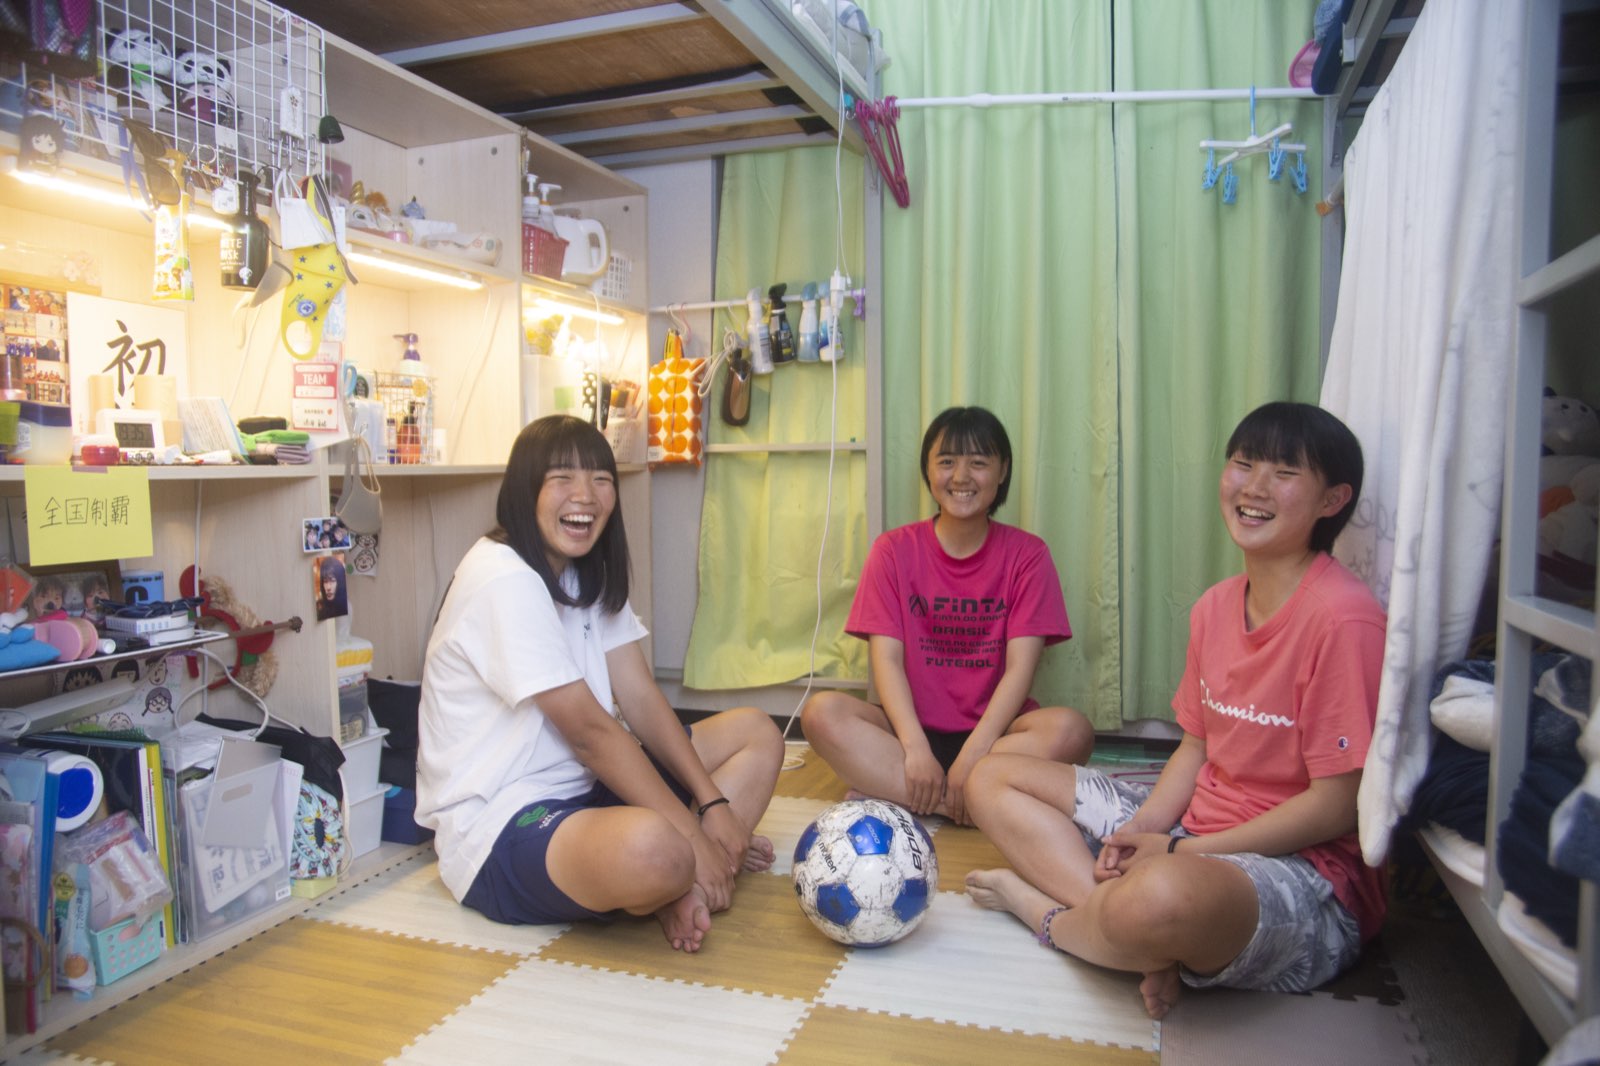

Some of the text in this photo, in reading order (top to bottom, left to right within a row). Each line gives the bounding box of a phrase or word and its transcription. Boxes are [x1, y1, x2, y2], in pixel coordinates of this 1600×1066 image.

[303, 373, 327, 385] TEAM
[40, 495, 130, 529] 全国制覇
[926, 656, 994, 668] FUTEBOL
[818, 841, 837, 874] molten
